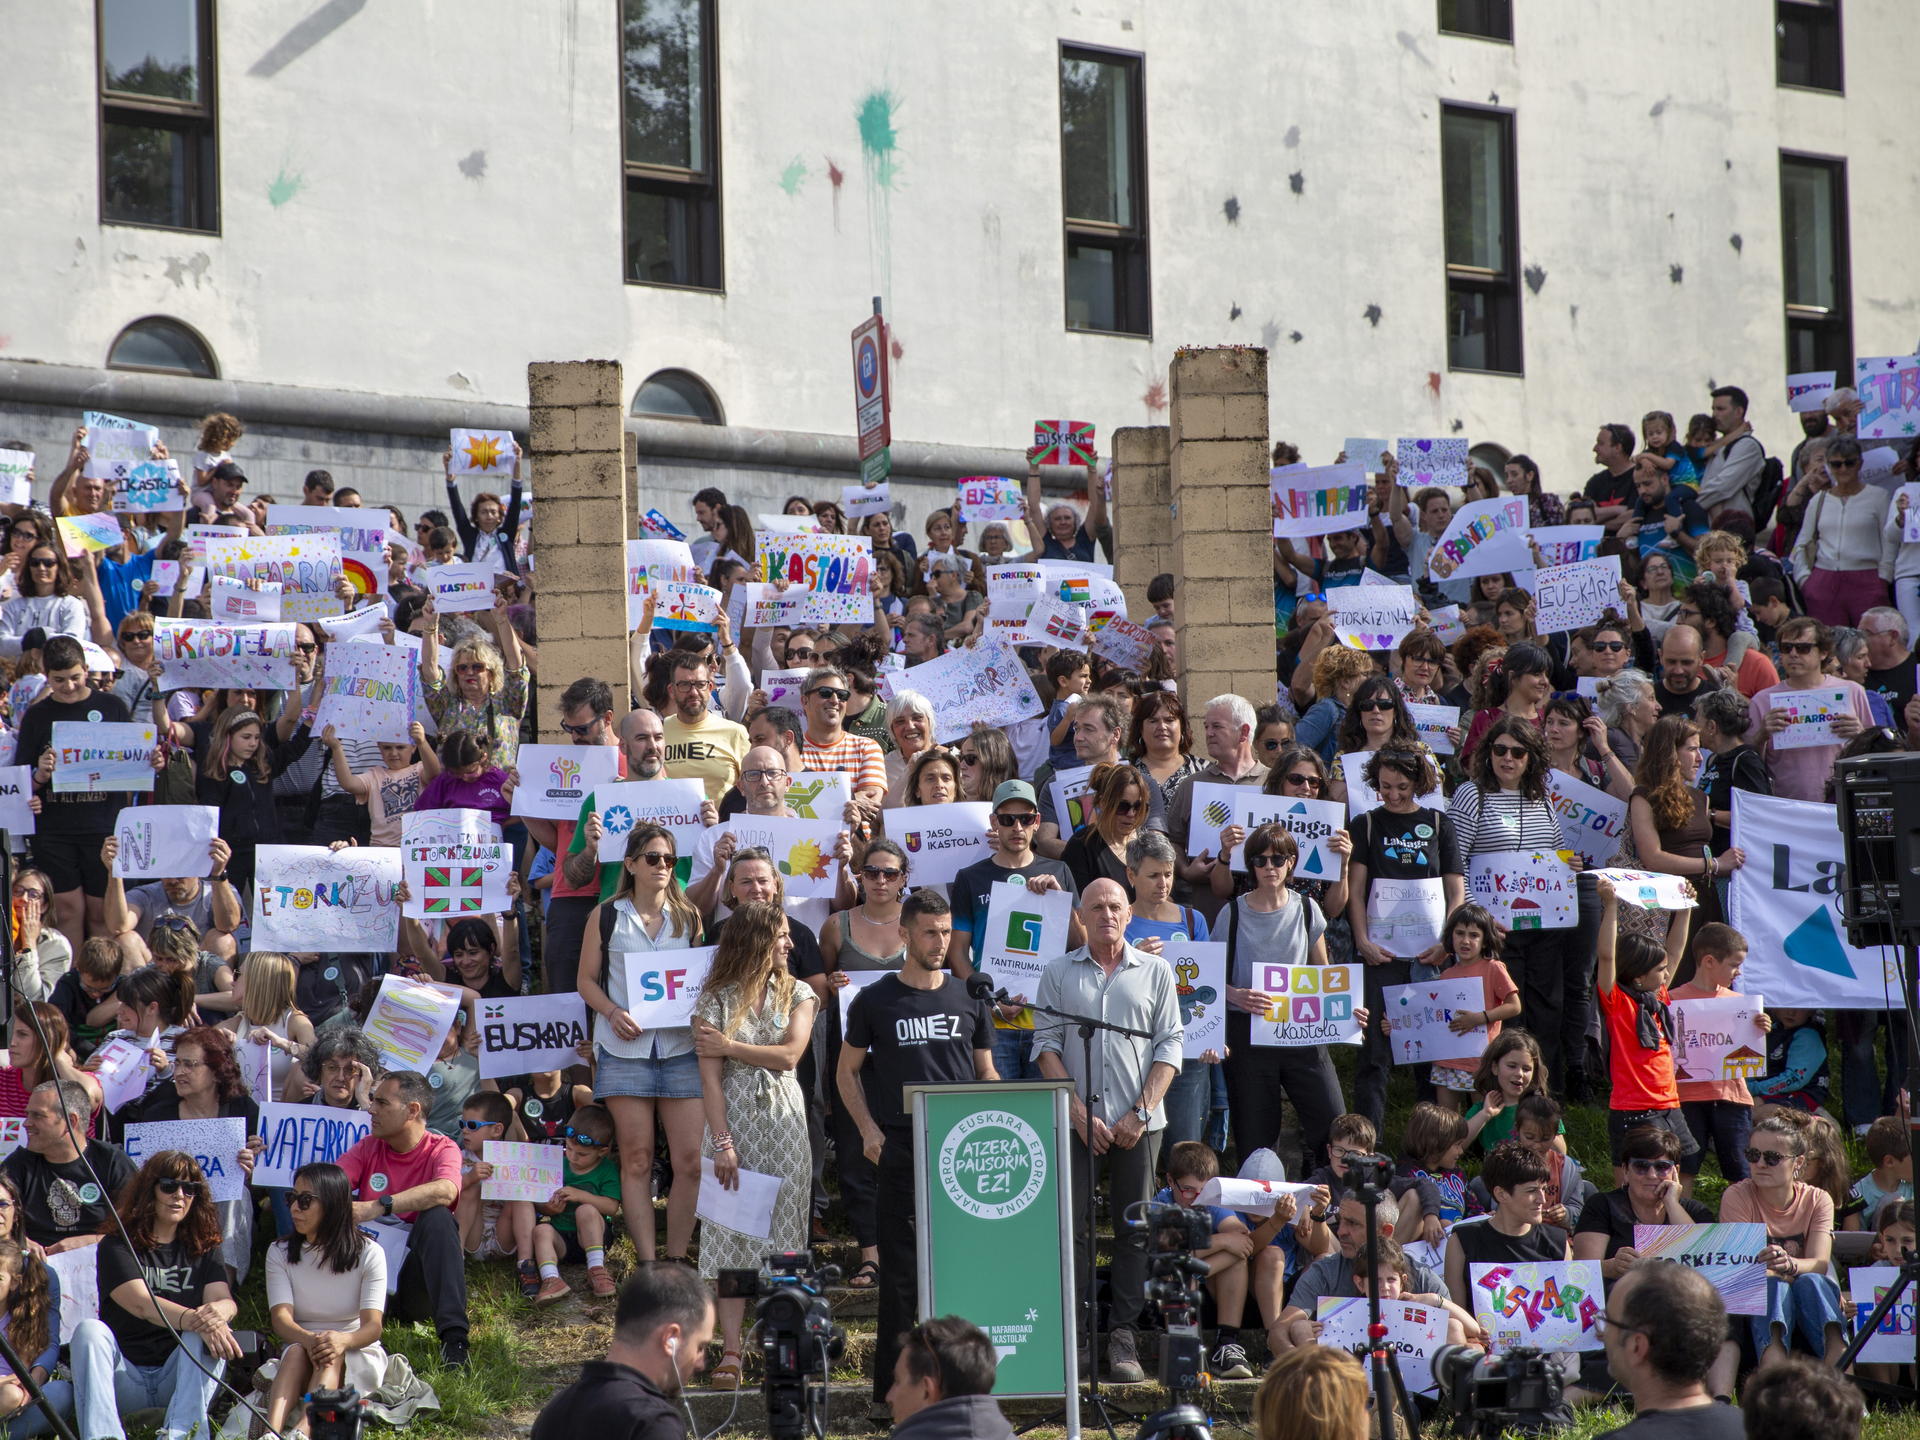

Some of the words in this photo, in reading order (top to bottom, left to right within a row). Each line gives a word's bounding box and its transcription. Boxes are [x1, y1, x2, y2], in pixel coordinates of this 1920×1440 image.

[1035, 433, 1086, 446] EUSKARA
[850, 496, 883, 505] IKASTOLA
[966, 488, 1022, 505] EUSKARA
[70, 526, 111, 541] EUSKARA
[761, 551, 869, 597] IKASTOLA
[993, 571, 1041, 580] ETORKIZUNA
[437, 582, 486, 593] IKASTOLA
[1538, 572, 1620, 609] EUSKARA
[756, 601, 796, 610] IKASTOLA
[1333, 606, 1413, 627] ETORKIZUNA
[161, 627, 293, 661] IKASTOLA
[1415, 723, 1451, 733] AFARROA
[62, 747, 150, 764] ETORKIZUNA
[664, 741, 716, 761] OINEZ
[637, 805, 680, 817] LIZARRA
[733, 829, 774, 845] ANDRA
[927, 829, 953, 839] JASO
[928, 837, 980, 850] IKASTOLA
[411, 846, 500, 862] ETORKIZUNA
[640, 969, 687, 1001] SF
[484, 1019, 585, 1053] EUSKARA
[895, 1013, 962, 1040] OINEZ
[1186, 1015, 1223, 1043] IKASTOLA
[1273, 1016, 1341, 1042] ikastola
[958, 1113, 1023, 1135] EUSKARA
[255, 1115, 370, 1171] NAFARRO
[962, 1138, 1020, 1157] ATZERA
[955, 1153, 1029, 1174] PAUSORIK
[942, 1146, 981, 1214] NAFARROA
[976, 1170, 1010, 1194] EZ!
[996, 1140, 1044, 1216] ETORKIZUNA
[145, 1265, 194, 1292] INEZ
[1478, 1265, 1599, 1334] EUSKARA
[991, 1324, 1033, 1334] NAFARROAKO
[991, 1334, 1027, 1344] IKASTOLAK
[1180, 1374, 1196, 1387] 99
